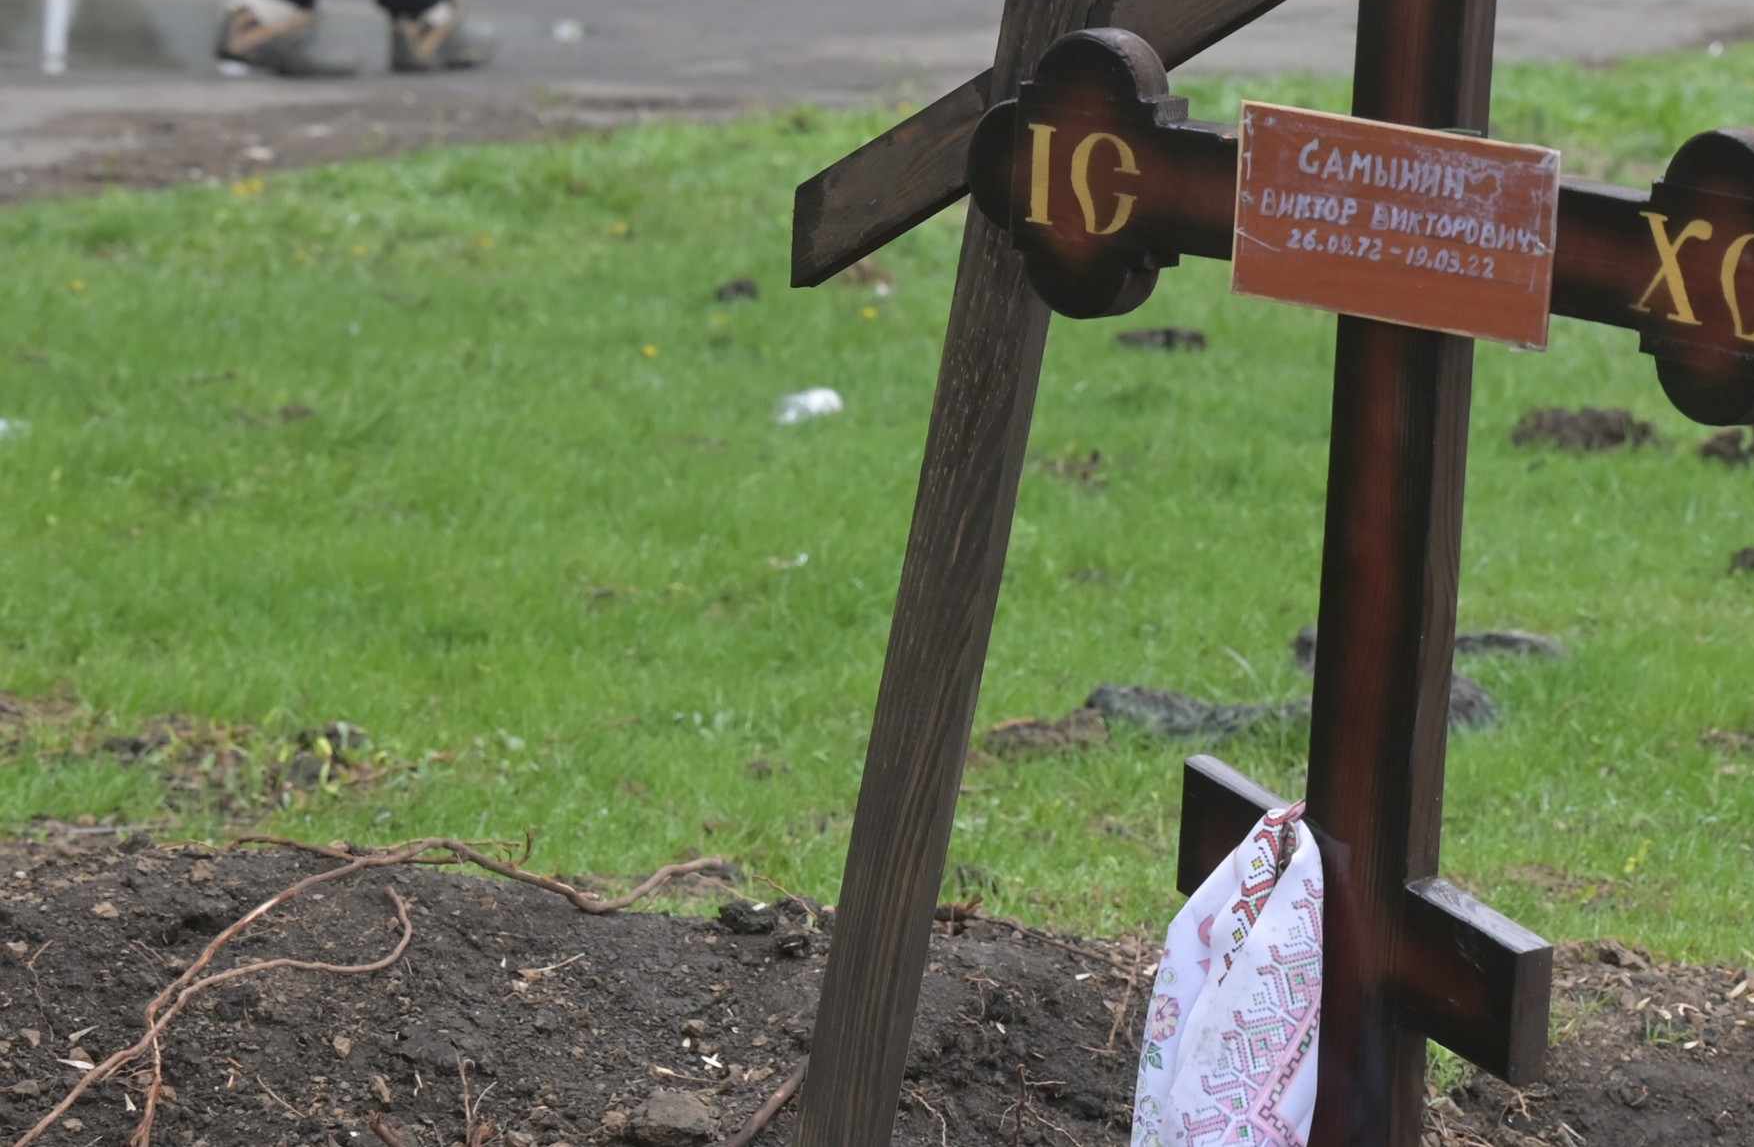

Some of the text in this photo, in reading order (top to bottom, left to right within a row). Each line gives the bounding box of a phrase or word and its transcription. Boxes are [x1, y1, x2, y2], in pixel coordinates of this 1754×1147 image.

[1298, 138, 1467, 200] САМЫНИН
[1259, 187, 1532, 254] ВИКТОР ВИКТОРОВИЧ
